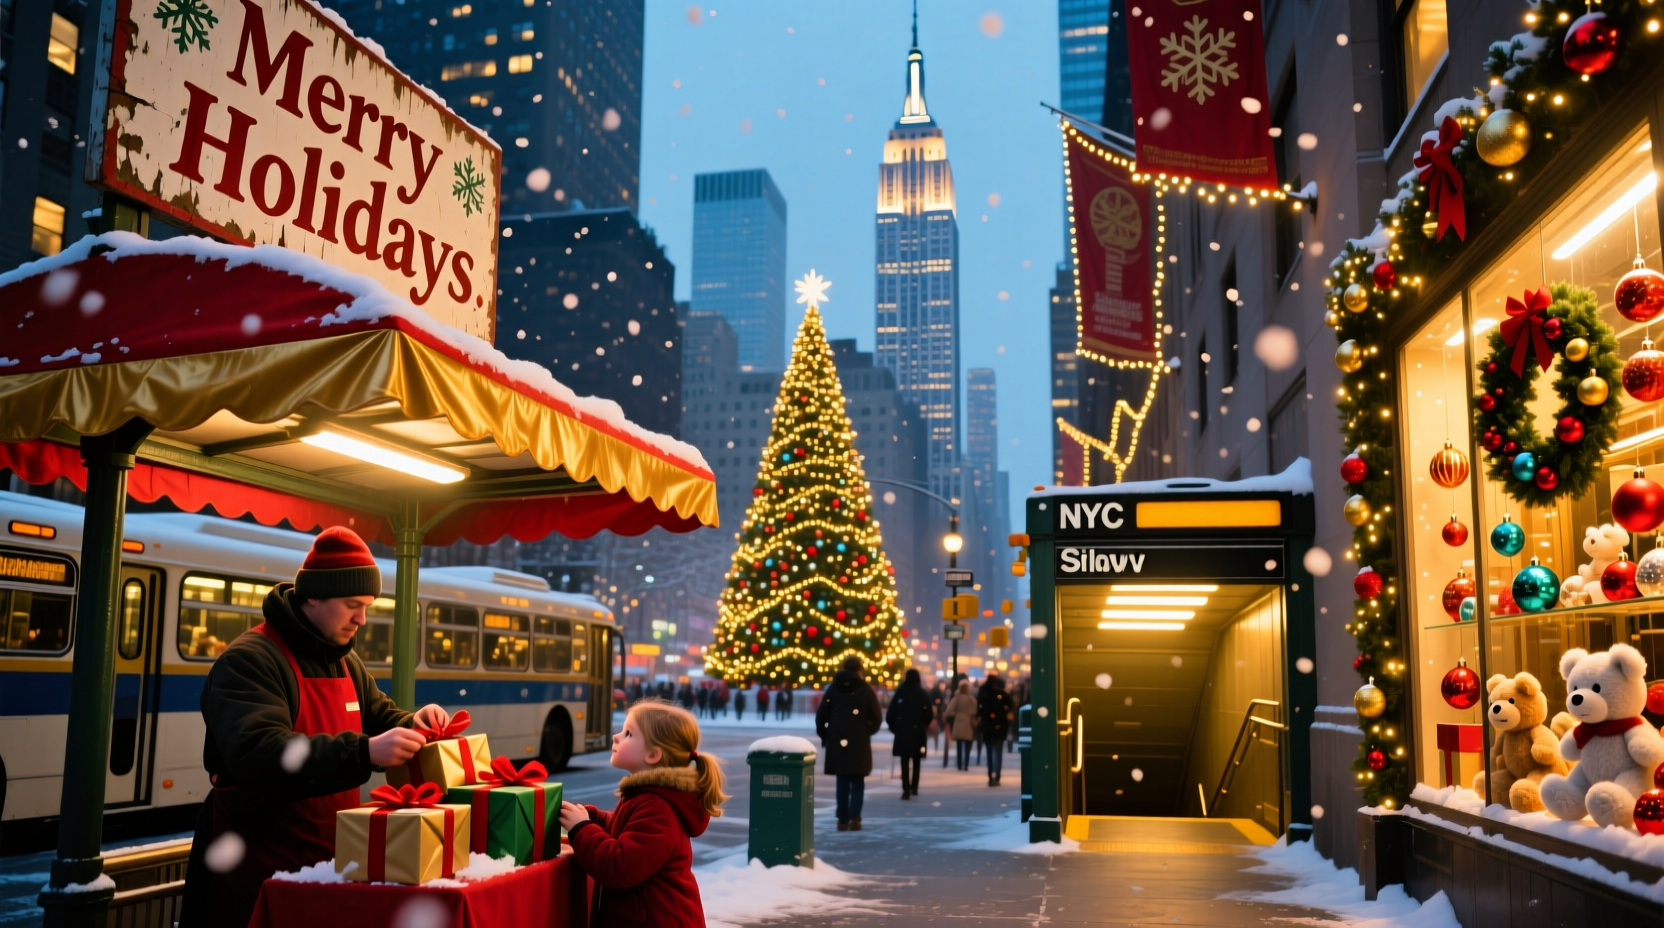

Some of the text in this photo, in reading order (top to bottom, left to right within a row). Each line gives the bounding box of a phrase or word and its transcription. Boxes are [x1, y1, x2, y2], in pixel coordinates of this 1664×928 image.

[169, 81, 484, 309] Holidays.
[227, 0, 443, 204] Merry
[1060, 502, 1124, 529] NYC
